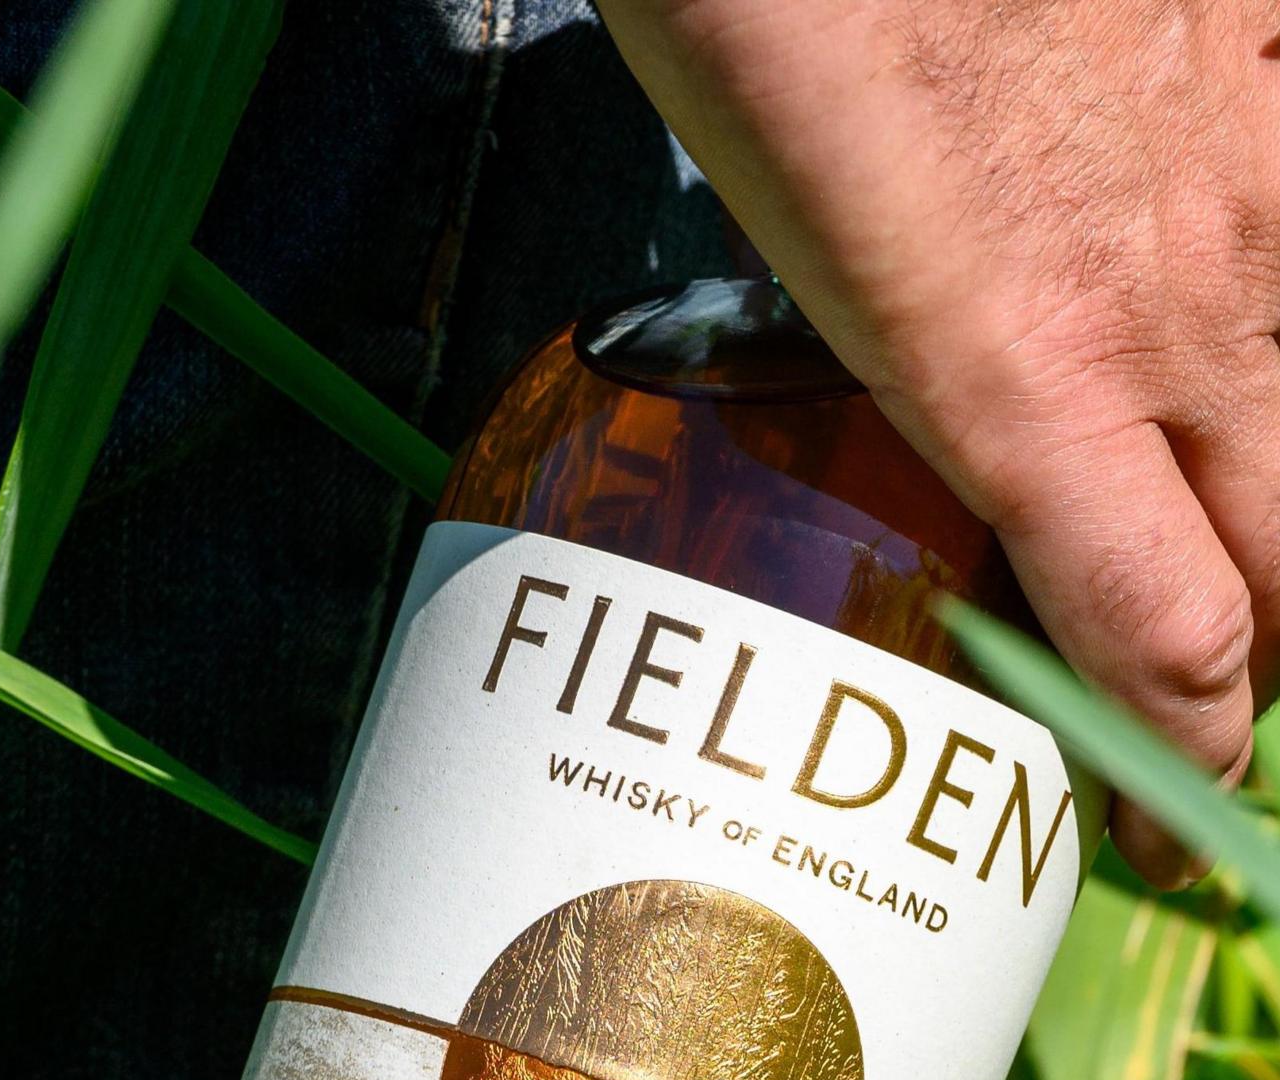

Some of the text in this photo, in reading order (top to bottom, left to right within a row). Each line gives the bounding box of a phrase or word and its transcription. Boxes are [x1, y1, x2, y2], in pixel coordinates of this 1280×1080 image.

[482, 574, 1073, 908] FIELDEN
[547, 752, 949, 933] WHISKY OF ENGLAND
